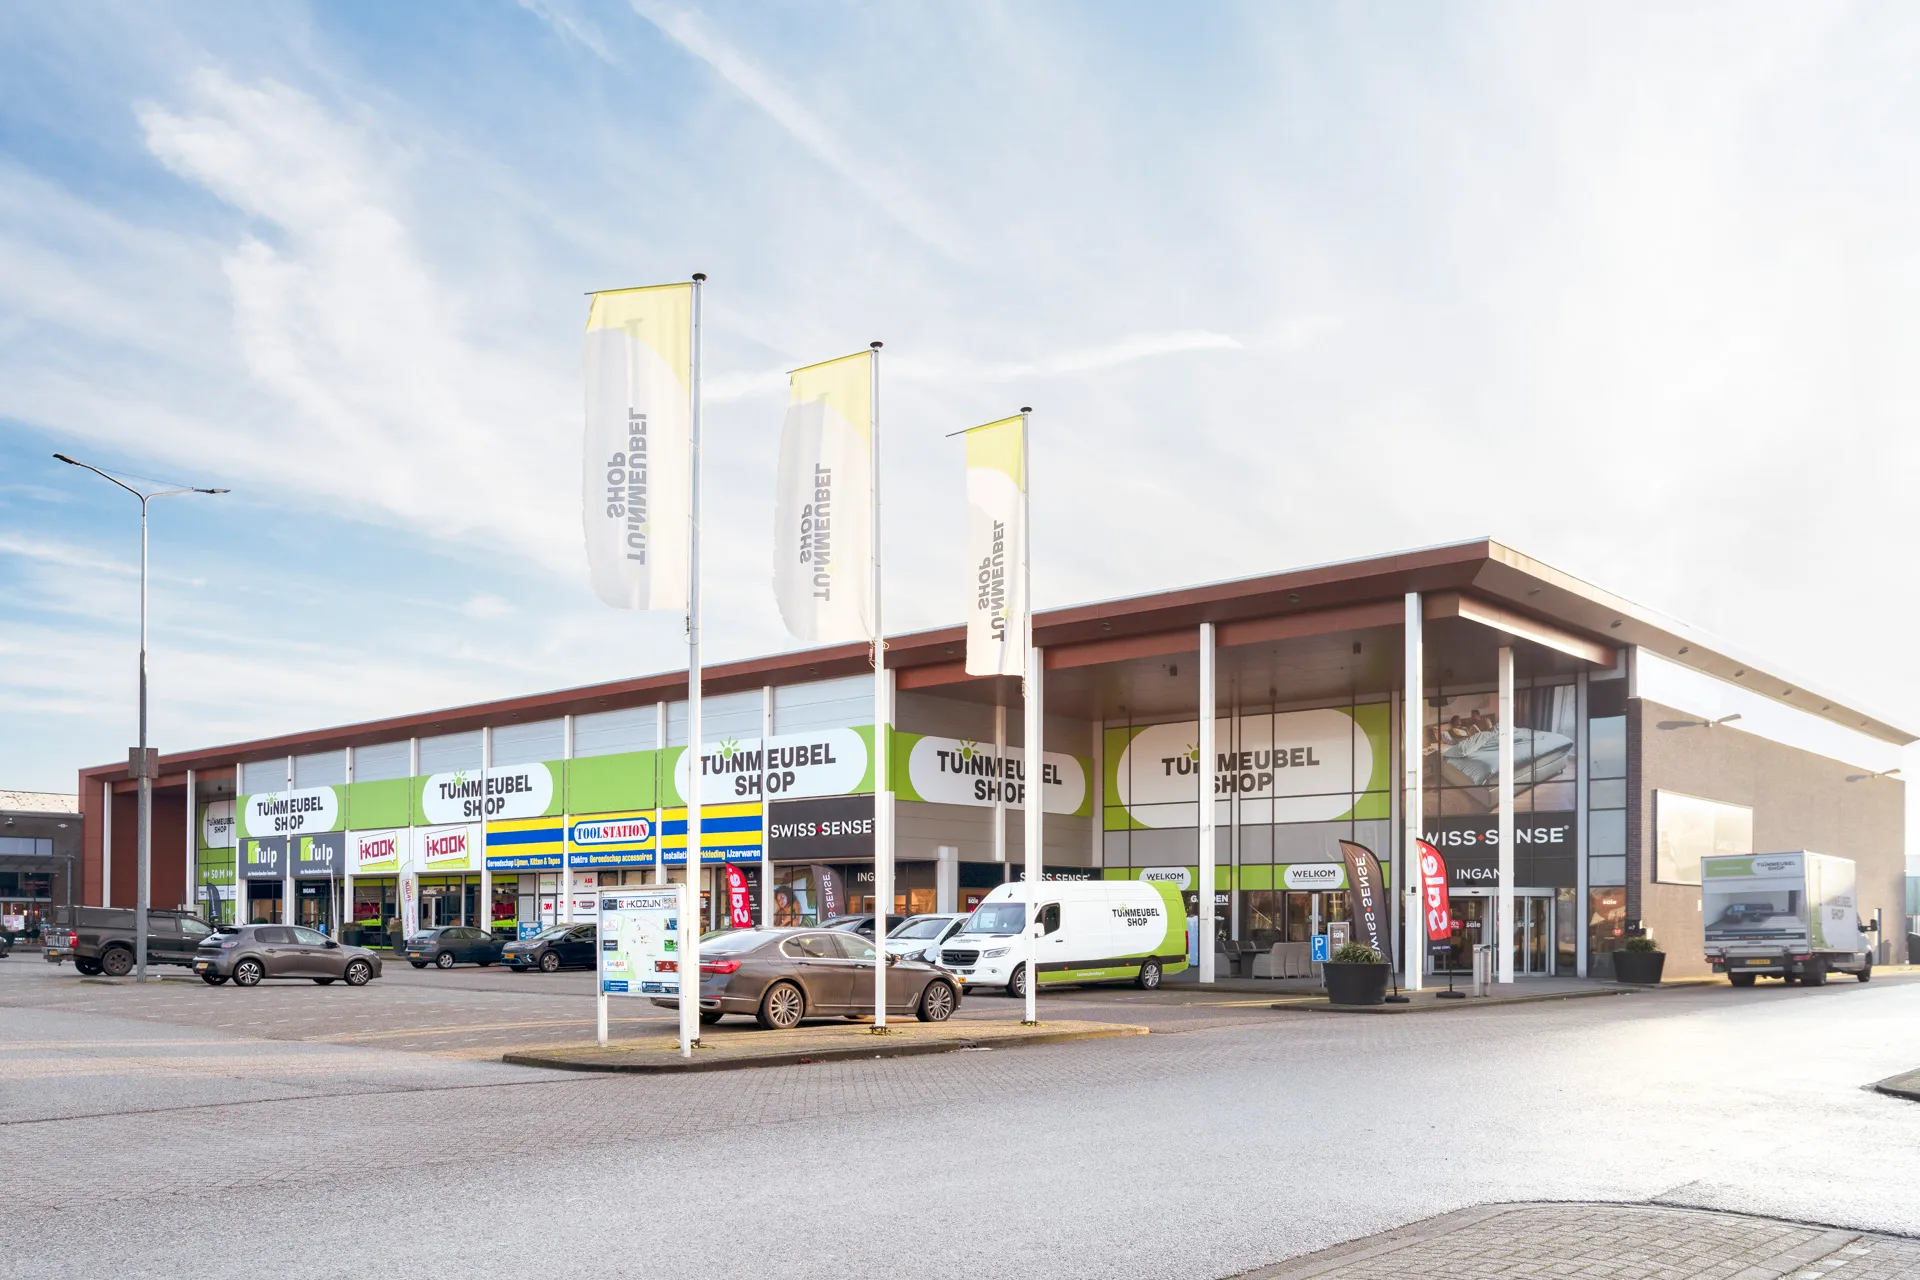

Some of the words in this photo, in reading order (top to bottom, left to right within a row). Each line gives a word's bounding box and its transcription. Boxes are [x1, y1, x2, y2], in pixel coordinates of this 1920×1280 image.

[937, 750, 1062, 785] TUiNMEUEL
[1162, 746, 1320, 776] TUiMEUBEL
[735, 771, 795, 796] SHOP
[463, 797, 506, 817] SHOP
[214, 825, 227, 833] SHOP
[274, 815, 304, 832] SHOP
[576, 823, 648, 840] TOOLSTATION
[1423, 830, 1477, 846] WISS
[1485, 827, 1564, 845] SNSE
[255, 847, 277, 868] Tulp
[309, 844, 333, 865] Tulp
[663, 851, 687, 860] Installati
[1146, 872, 1184, 880] WELKOM
[1292, 870, 1336, 878] WELKOM
[1456, 868, 1514, 880] INGAN
[626, 899, 661, 909] i-KOZIJN
[1127, 917, 1148, 927] SHOP
[1315, 938, 1324, 951] P
